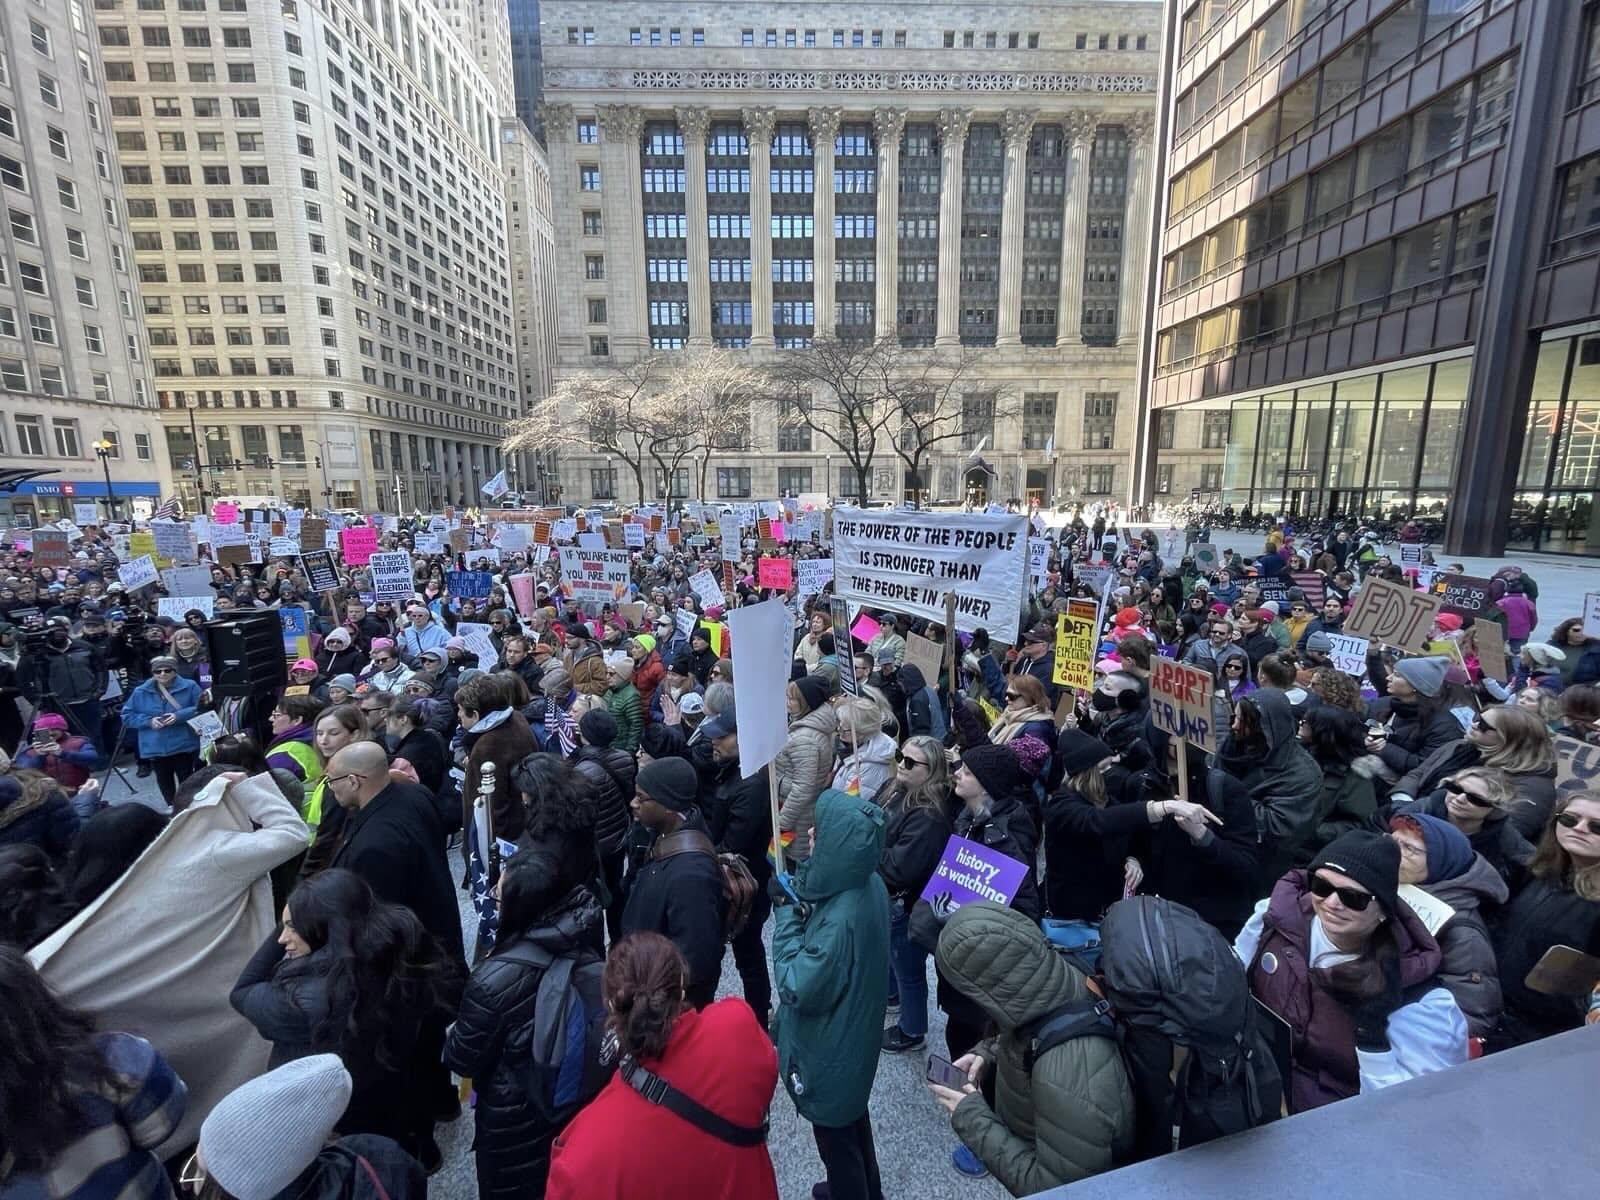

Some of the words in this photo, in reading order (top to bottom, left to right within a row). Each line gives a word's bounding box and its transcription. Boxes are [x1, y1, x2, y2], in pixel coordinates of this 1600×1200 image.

[36, 486, 60, 494] BMO
[837, 521, 856, 537] THE
[859, 523, 900, 542] POWER
[904, 526, 921, 543] OF
[924, 527, 951, 546] THE
[954, 529, 1017, 551] PEOPLE
[565, 550, 573, 560] IF
[576, 550, 591, 561] YOU
[592, 551, 609, 562] ARE
[610, 553, 629, 564] NOT
[373, 566, 409, 575] TRUMP'S
[860, 551, 870, 565] IS
[873, 552, 936, 578] STRONGER
[940, 560, 982, 582] THAN
[566, 569, 583, 579] YOU
[587, 571, 604, 581] ARE
[608, 572, 628, 582] NOT
[851, 575, 872, 592] THE
[874, 580, 919, 602] PEOPLE
[922, 588, 938, 607] IN
[1470, 590, 1485, 600] DO
[1440, 594, 1481, 610] ORCED
[1350, 582, 1436, 646] FDT
[1063, 618, 1094, 637] DEFY
[1064, 636, 1093, 651] THEIR
[1065, 660, 1087, 673] KEEP
[1060, 671, 1088, 687] GOING
[1152, 662, 1210, 708] ABORT
[1152, 698, 1209, 746] TRUMP
[937, 860, 948, 877] is
[955, 846, 1001, 882] history
